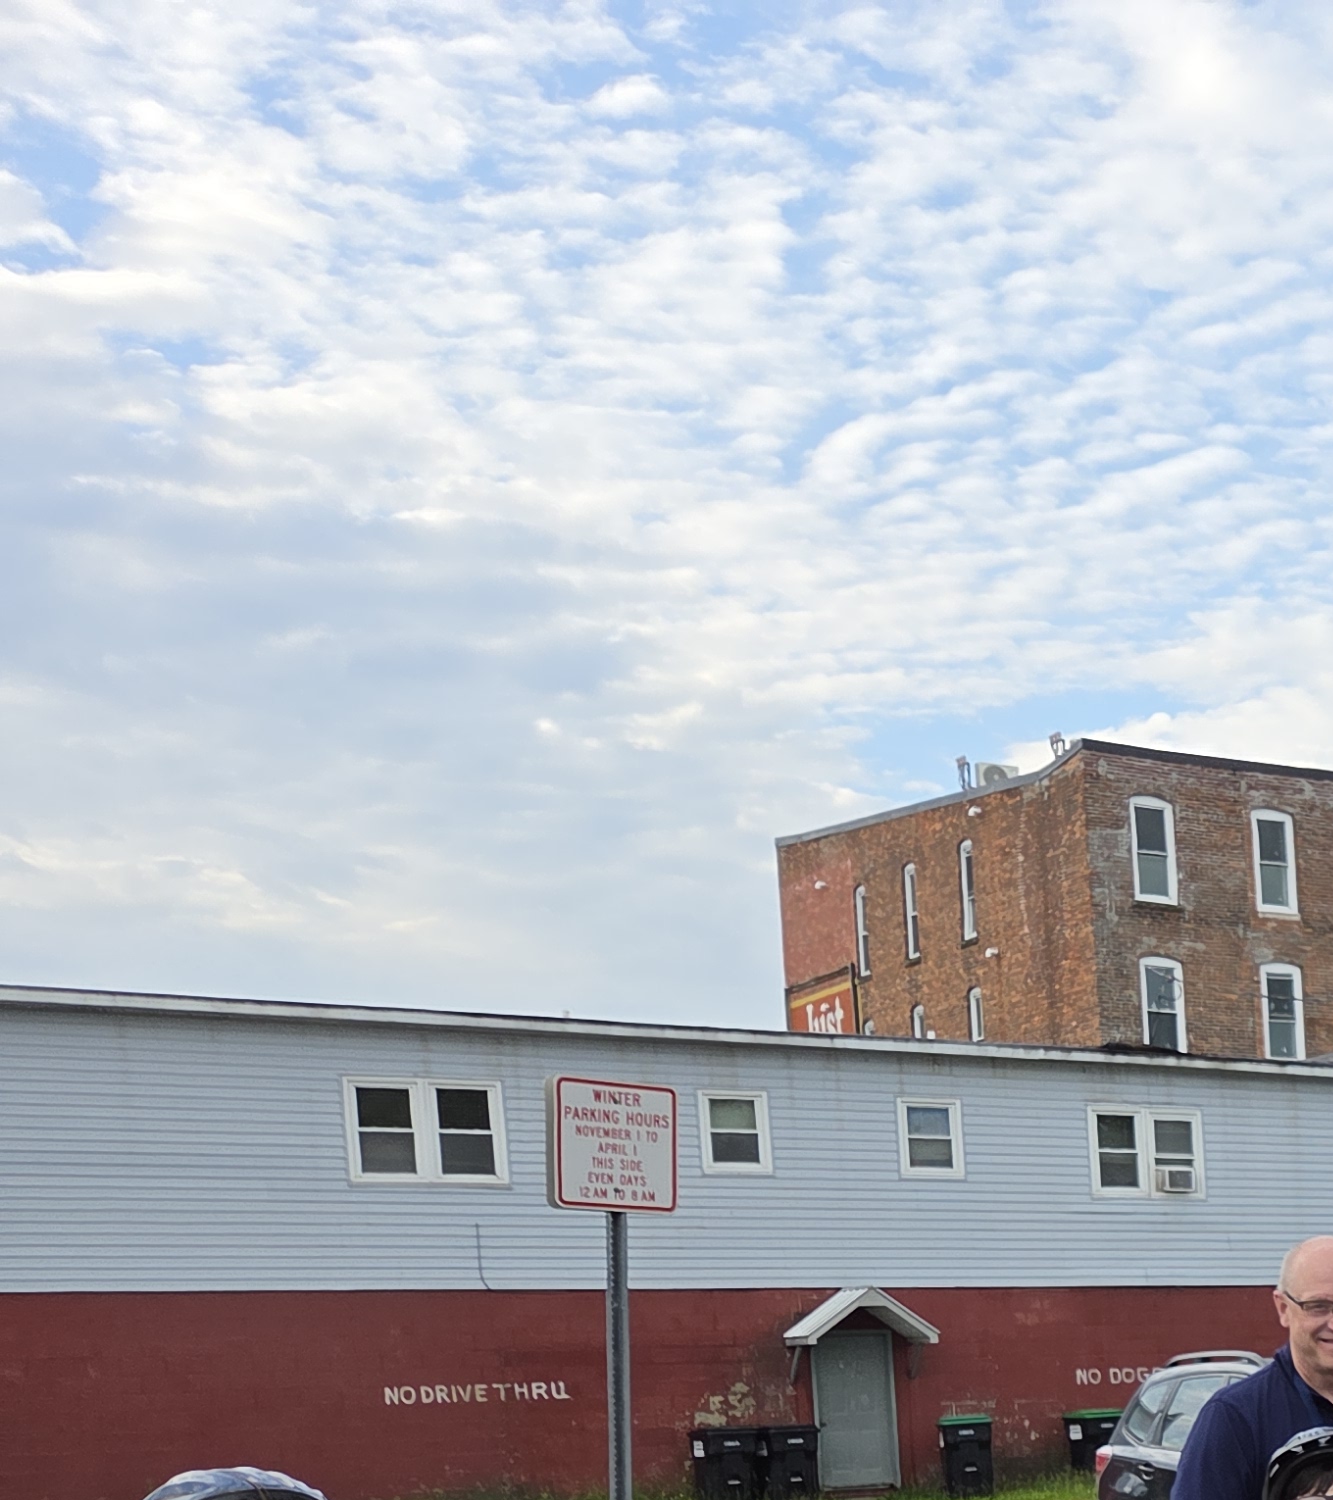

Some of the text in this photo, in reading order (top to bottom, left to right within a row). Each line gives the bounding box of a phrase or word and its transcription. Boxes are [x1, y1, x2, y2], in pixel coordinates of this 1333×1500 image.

[592, 1089, 642, 1107] WINTER
[564, 1106, 670, 1129] PARKING HOURS
[575, 1125, 631, 1141] NOVEMBER
[645, 1130, 658, 1143] TO
[598, 1141, 628, 1156] APRIL
[592, 1157, 644, 1172] THIS SIDE
[588, 1172, 647, 1187] EVEN DAYS
[579, 1186, 590, 1197] 12
[593, 1187, 608, 1199] AM
[613, 1188, 625, 1200] TO
[641, 1190, 656, 1202] AM
[1075, 1367, 1163, 1385] NO DOG
[384, 1386, 417, 1405] NO
[420, 1384, 489, 1403] DRIVE
